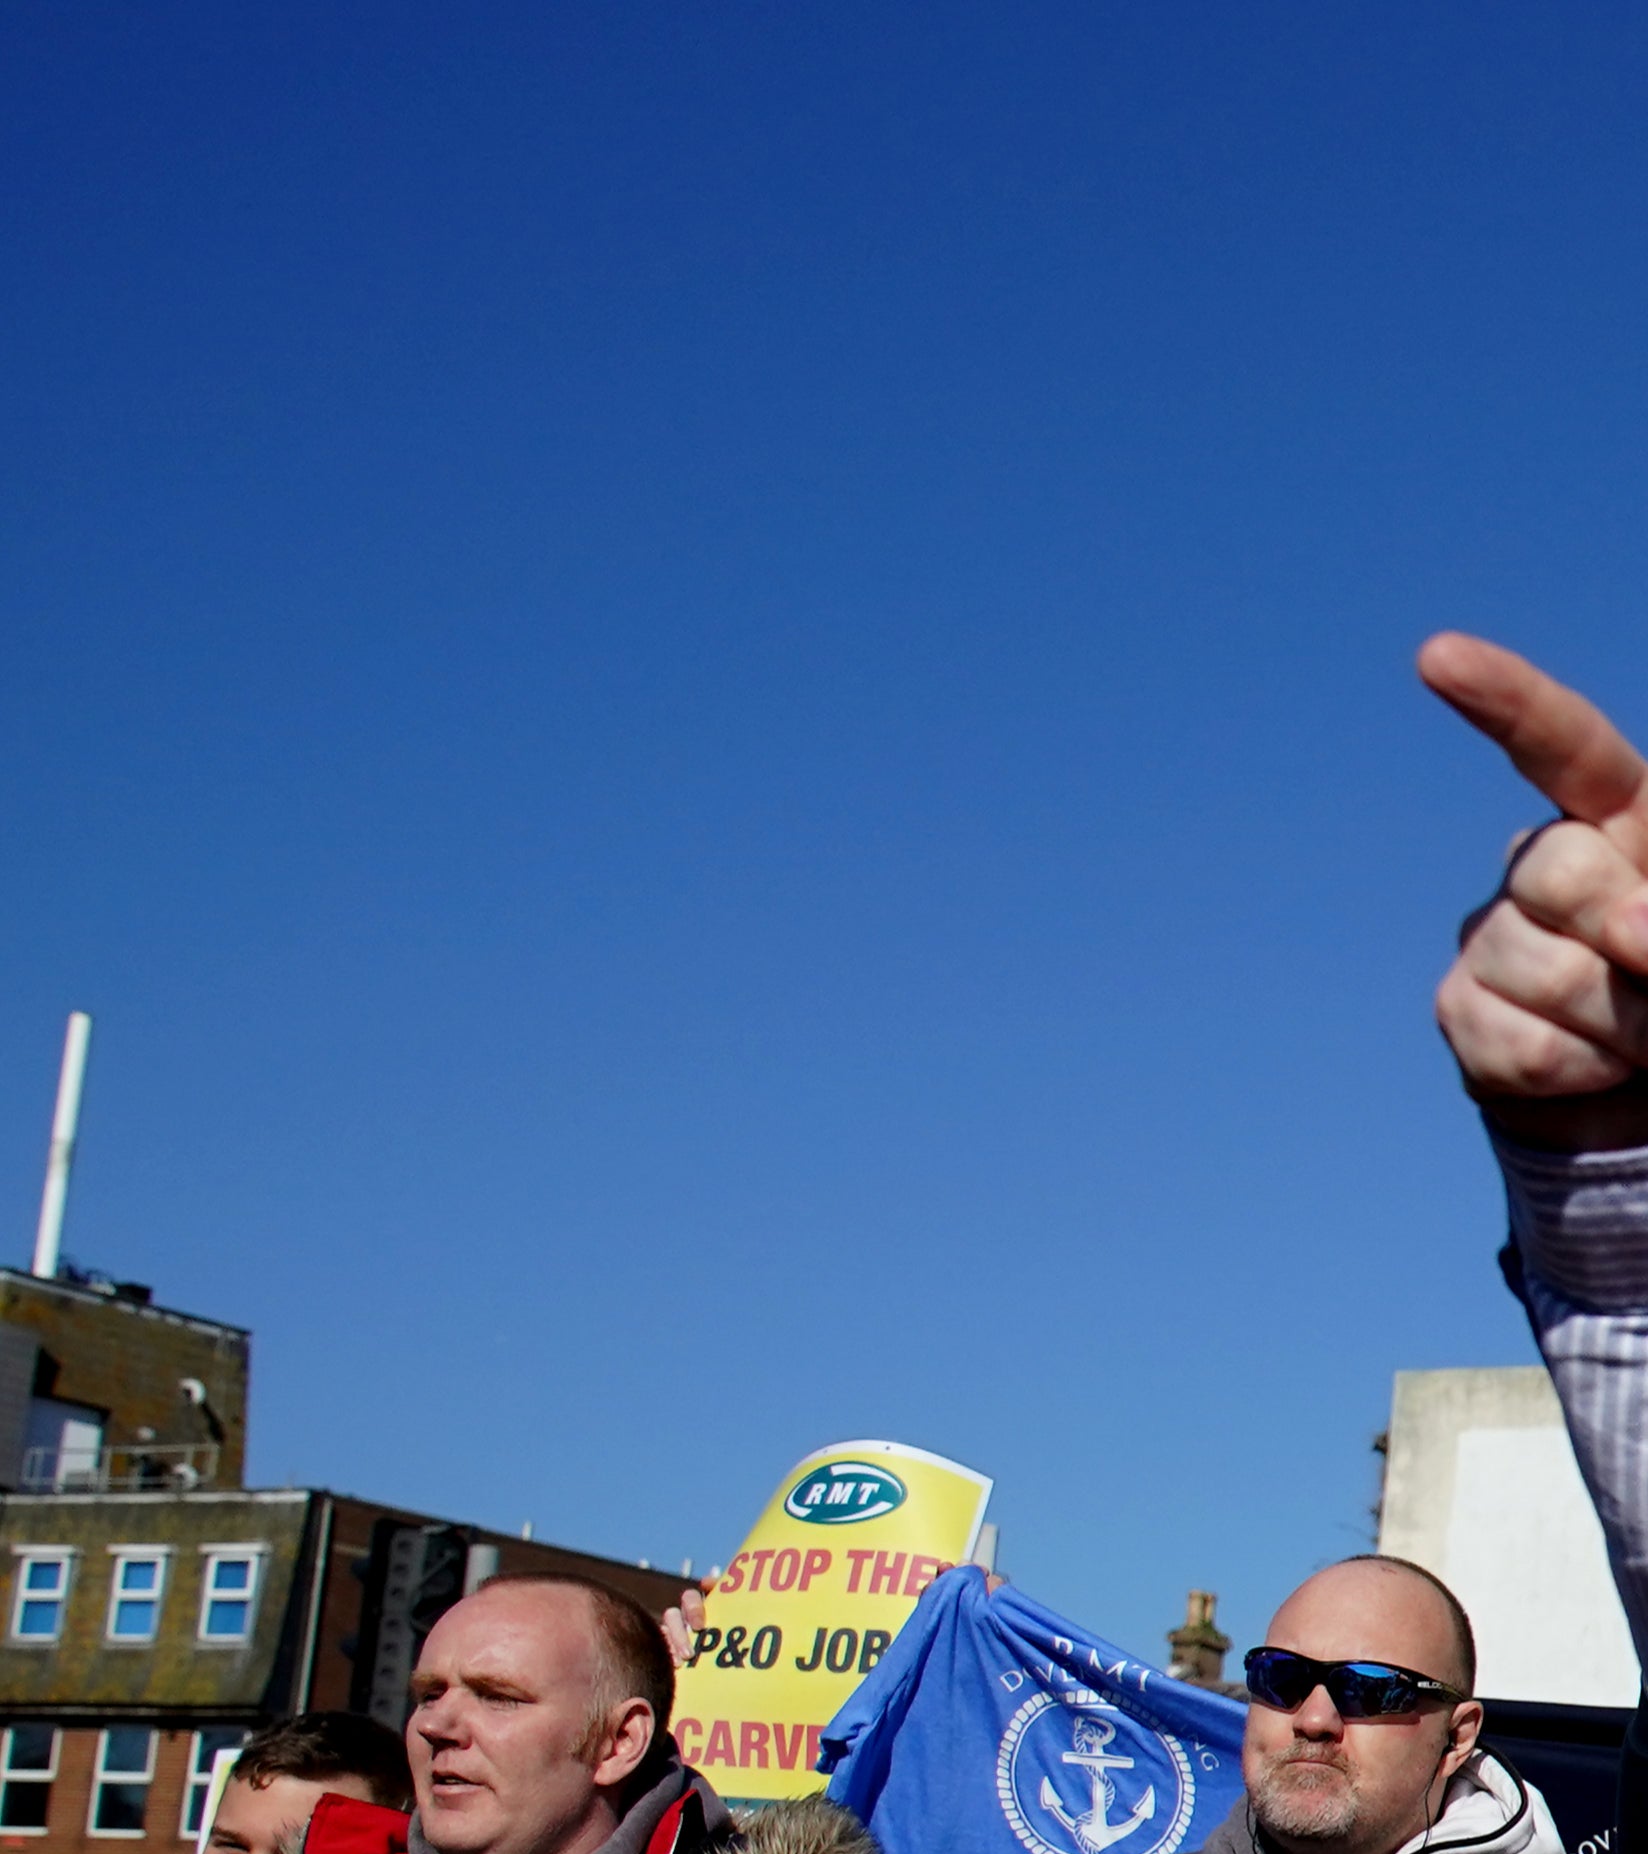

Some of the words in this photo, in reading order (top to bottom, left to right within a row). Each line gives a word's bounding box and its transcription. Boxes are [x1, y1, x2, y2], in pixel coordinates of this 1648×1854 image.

[803, 1481, 880, 1507] RMT
[719, 1548, 833, 1594] STOP
[846, 1549, 940, 1598] THE
[686, 1625, 782, 1670] P&O
[795, 1626, 893, 1676] JOB
